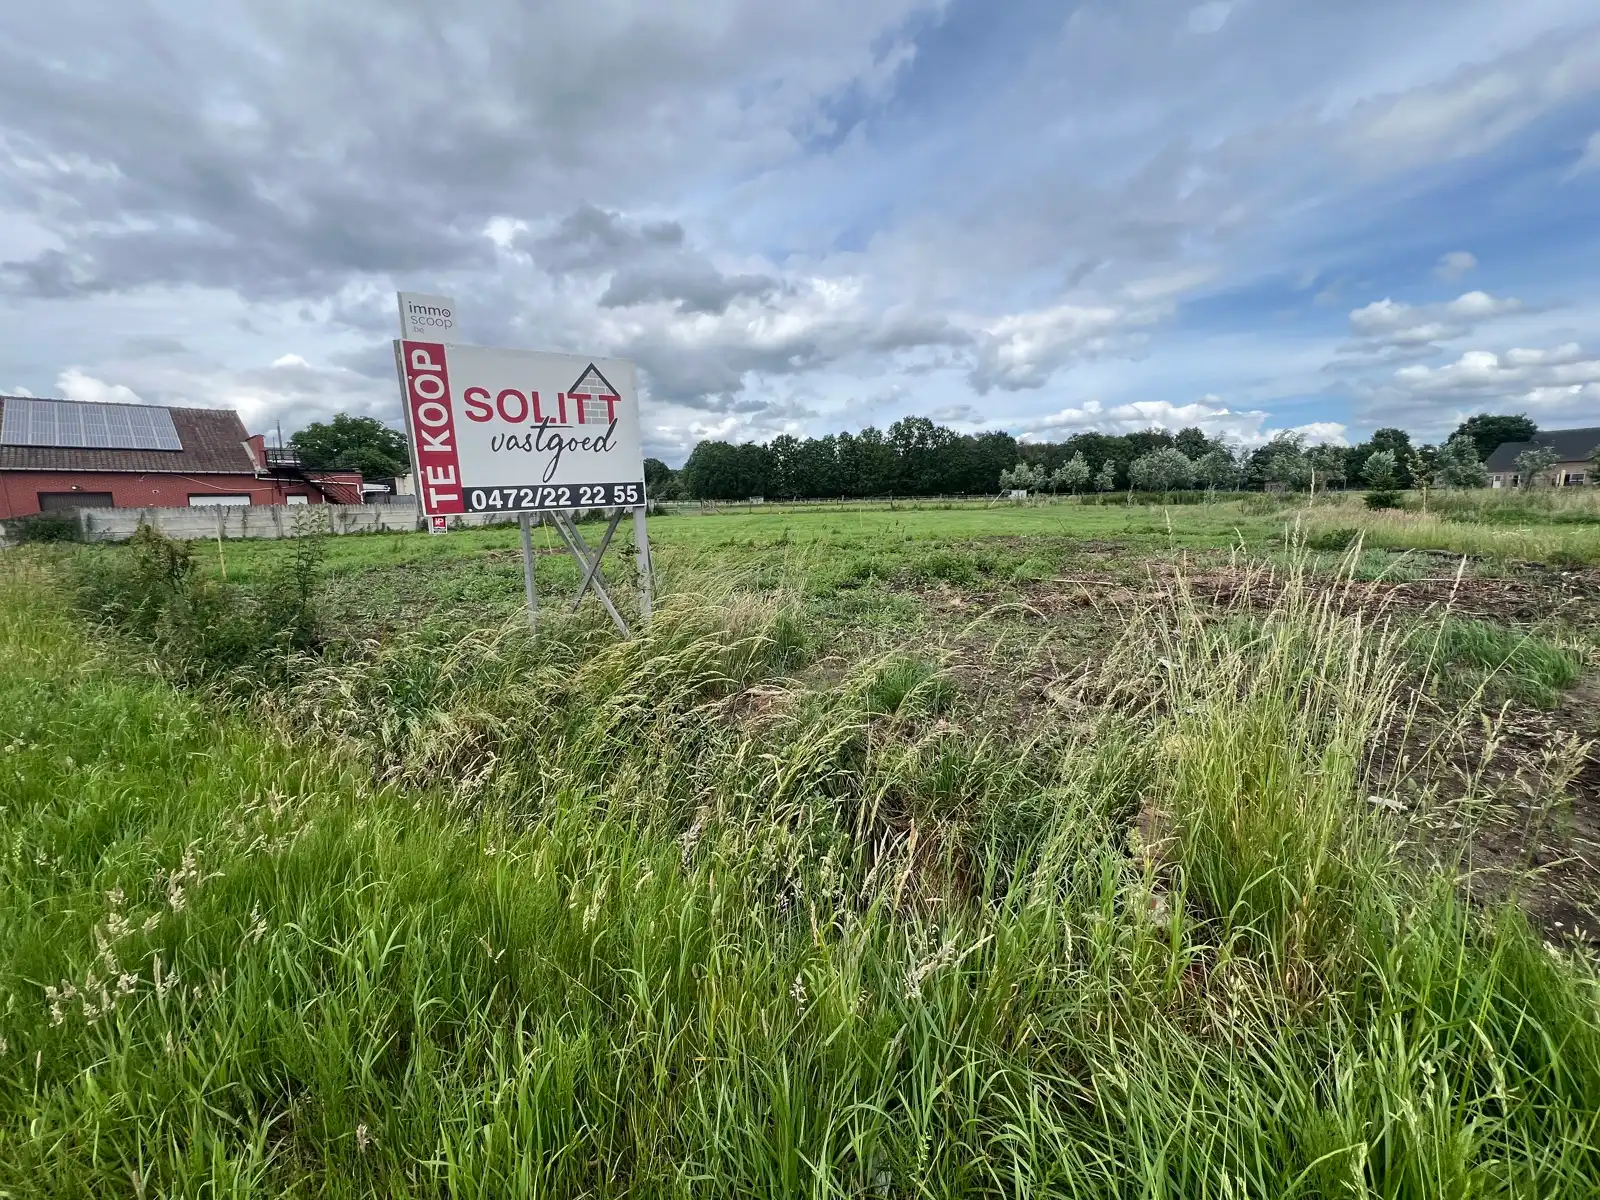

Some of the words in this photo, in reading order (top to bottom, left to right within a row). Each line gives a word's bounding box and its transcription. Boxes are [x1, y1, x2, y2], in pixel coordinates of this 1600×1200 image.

[409, 301, 451, 317] immo
[411, 315, 453, 329] scoop
[411, 349, 453, 452] KOOP
[464, 387, 621, 424] SOLITT
[491, 416, 618, 483] vastgoed
[427, 465, 458, 509] TE
[471, 487, 571, 510] 0472/22
[579, 486, 606, 505] 22
[613, 485, 638, 503] 55
